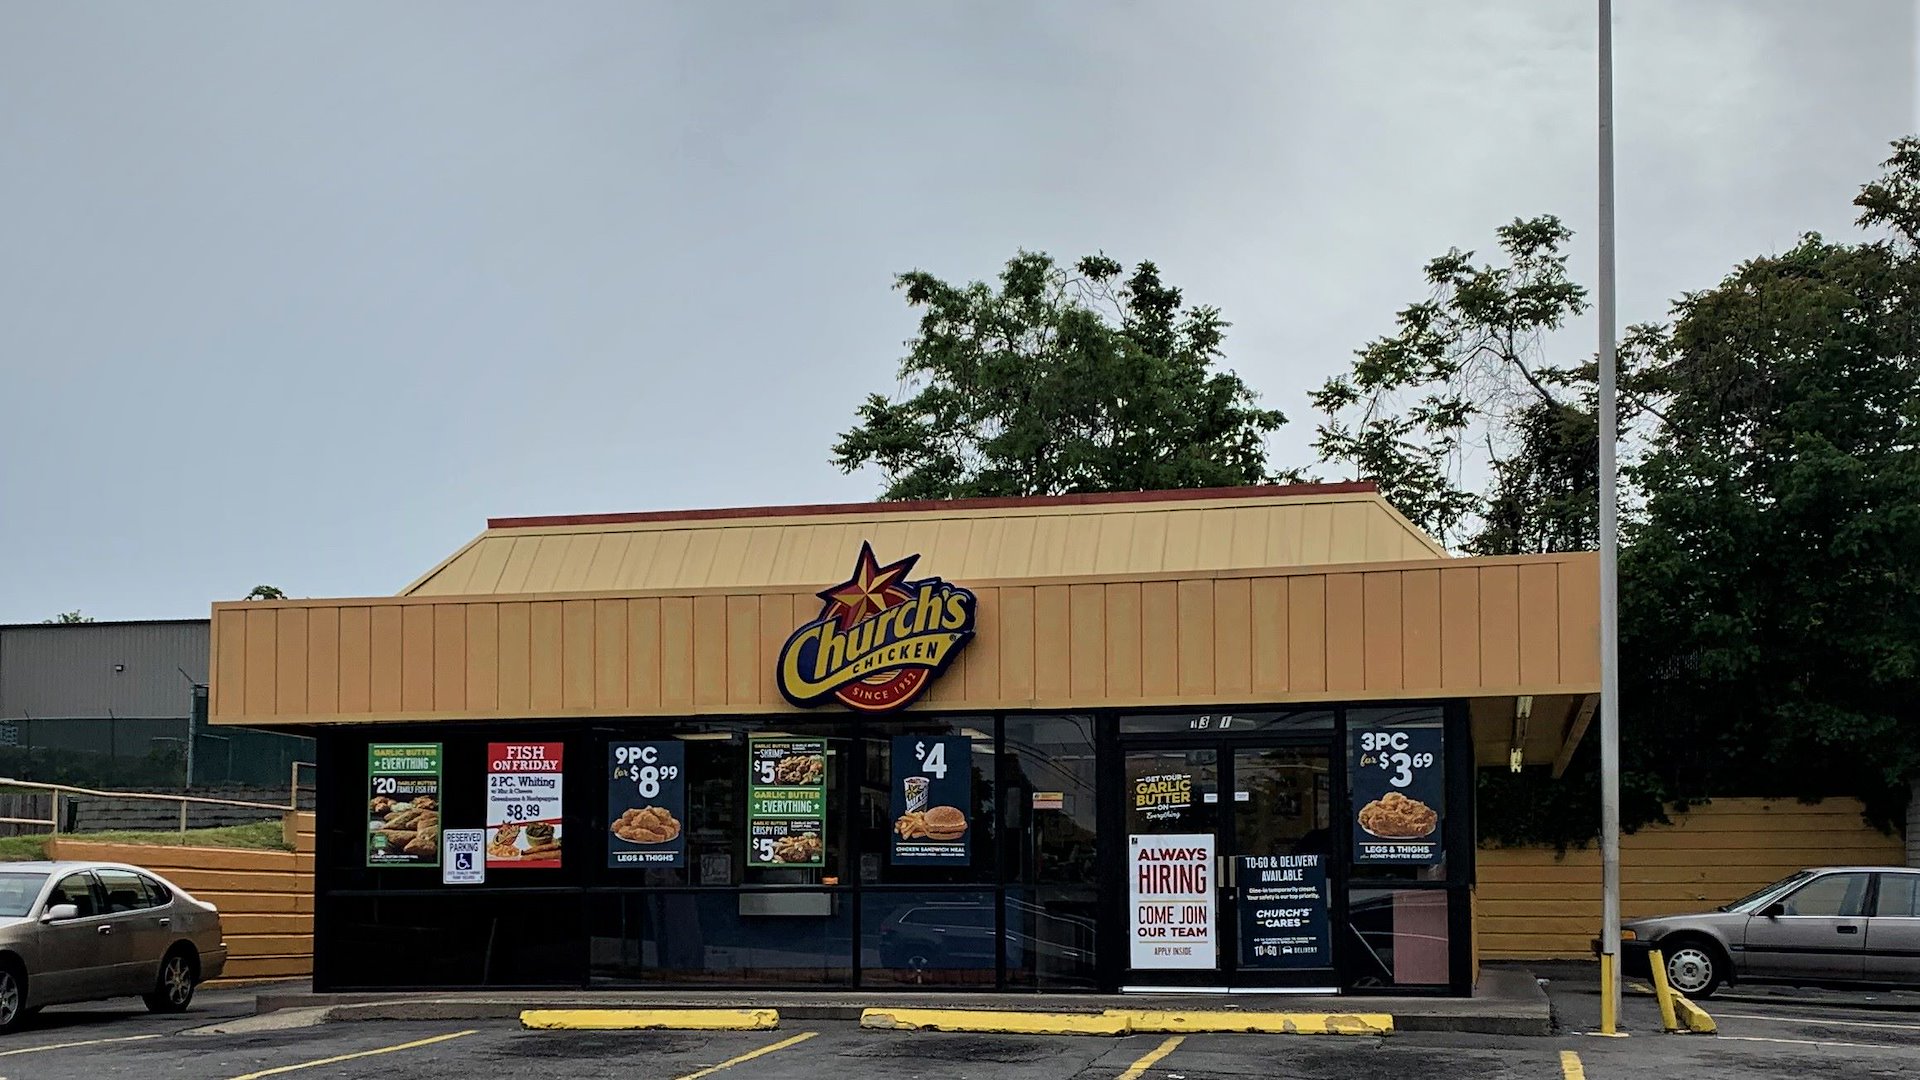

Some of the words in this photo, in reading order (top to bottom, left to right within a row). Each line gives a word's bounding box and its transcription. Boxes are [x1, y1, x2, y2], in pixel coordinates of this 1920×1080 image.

[783, 585, 967, 699] Church's
[852, 641, 939, 674] CHICKEN
[852, 687, 889, 700] SINCE
[893, 672, 916, 695] 1952
[1361, 732, 1409, 751] 3PC
[506, 746, 545, 760] FISH
[615, 746, 657, 764] 9PC
[381, 757, 429, 770] EVERYTHING
[492, 760, 511, 771] ON
[512, 760, 559, 771] FRIDAY
[915, 741, 948, 779] $4
[1360, 753, 1377, 767] for
[613, 767, 629, 779] for
[754, 759, 775, 784] $5
[373, 777, 397, 794] $20
[491, 776, 497, 787] 2
[518, 776, 555, 789] Whiting
[1145, 775, 1160, 783] GET
[1136, 780, 1191, 794] GARLIC
[754, 791, 786, 799] GARLIC
[788, 791, 820, 799] BUTTER
[1136, 792, 1191, 806] BUTTER
[507, 804, 540, 820] $8.99
[762, 800, 812, 813] EVERYTHING
[1146, 810, 1181, 820] Everything
[774, 826, 788, 835] FISH
[446, 833, 481, 843] RESERVED
[449, 843, 478, 852] PARKING
[752, 837, 774, 862] $5
[617, 854, 638, 862] LEGS
[645, 854, 674, 862] THIGHS
[1138, 848, 1207, 861] ALWAYS
[1245, 856, 1268, 869] TO-GO
[1270, 856, 1278, 868] &
[1280, 855, 1318, 867] DELIVERY
[1139, 864, 1207, 894] HIRING
[1262, 869, 1304, 882] AVAILABLE
[1138, 906, 1175, 924] COME
[1178, 906, 1207, 924] JOIN
[1256, 908, 1310, 918] CHURCH'S
[1265, 918, 1301, 928] CARES
[1138, 927, 1166, 937] OUR
[1171, 927, 1207, 937] TEAM
[1154, 947, 1171, 956] APPLY
[1172, 946, 1192, 956] INSIDE
